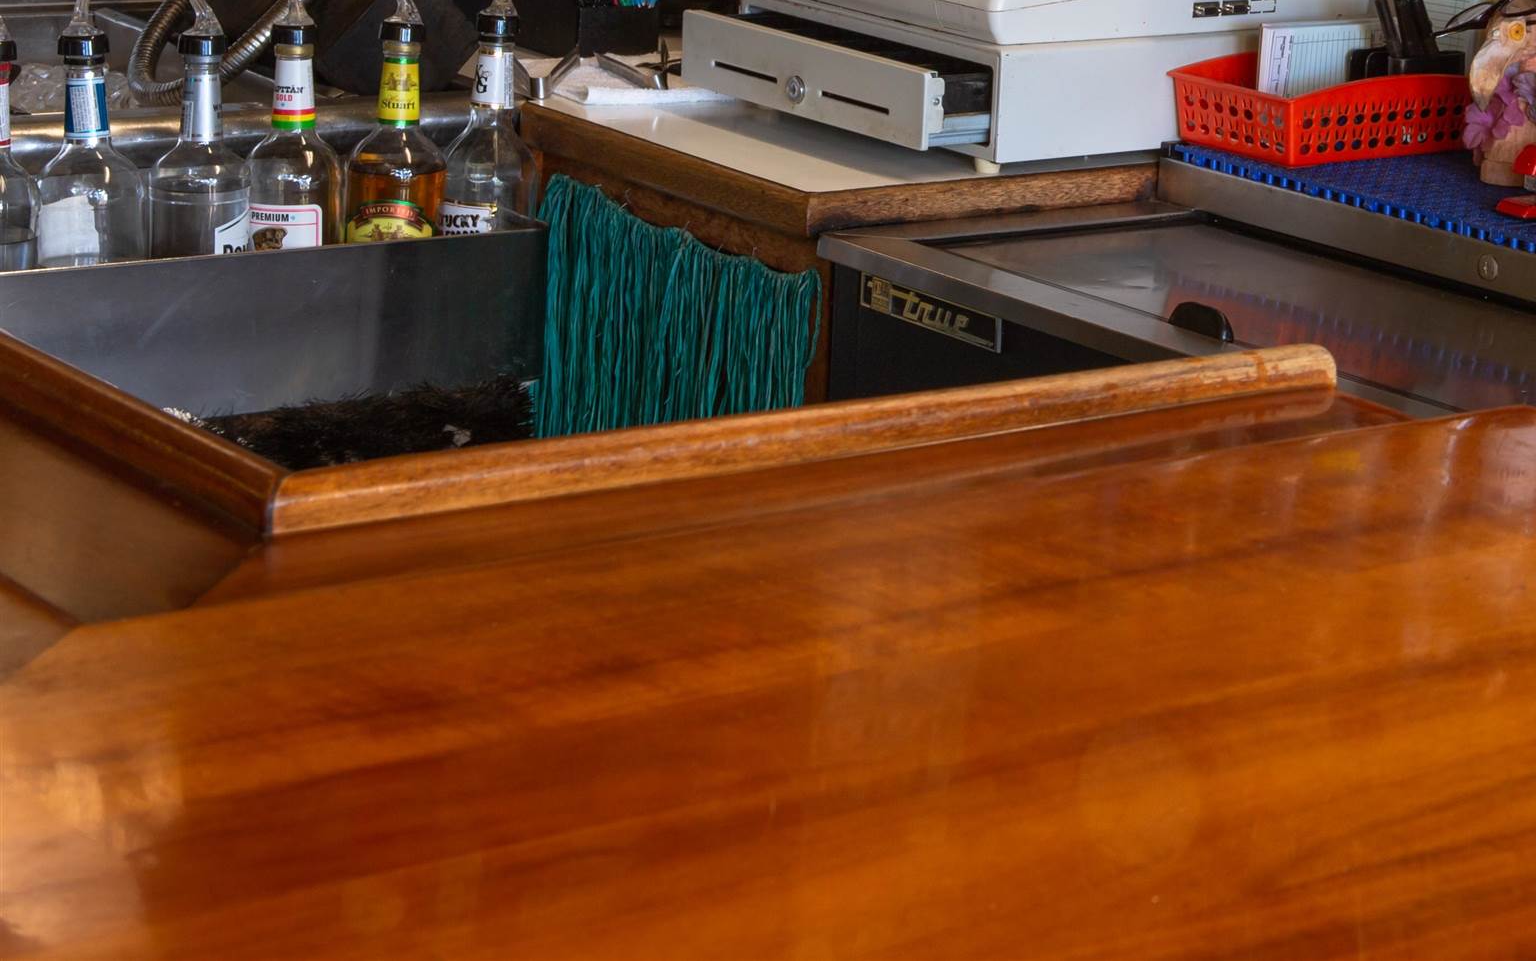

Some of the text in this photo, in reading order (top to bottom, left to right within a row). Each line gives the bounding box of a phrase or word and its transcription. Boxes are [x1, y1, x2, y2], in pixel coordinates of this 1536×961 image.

[382, 98, 416, 112] Stuart
[250, 211, 290, 223] PREMIUM
[364, 204, 417, 220] IMPORTED
